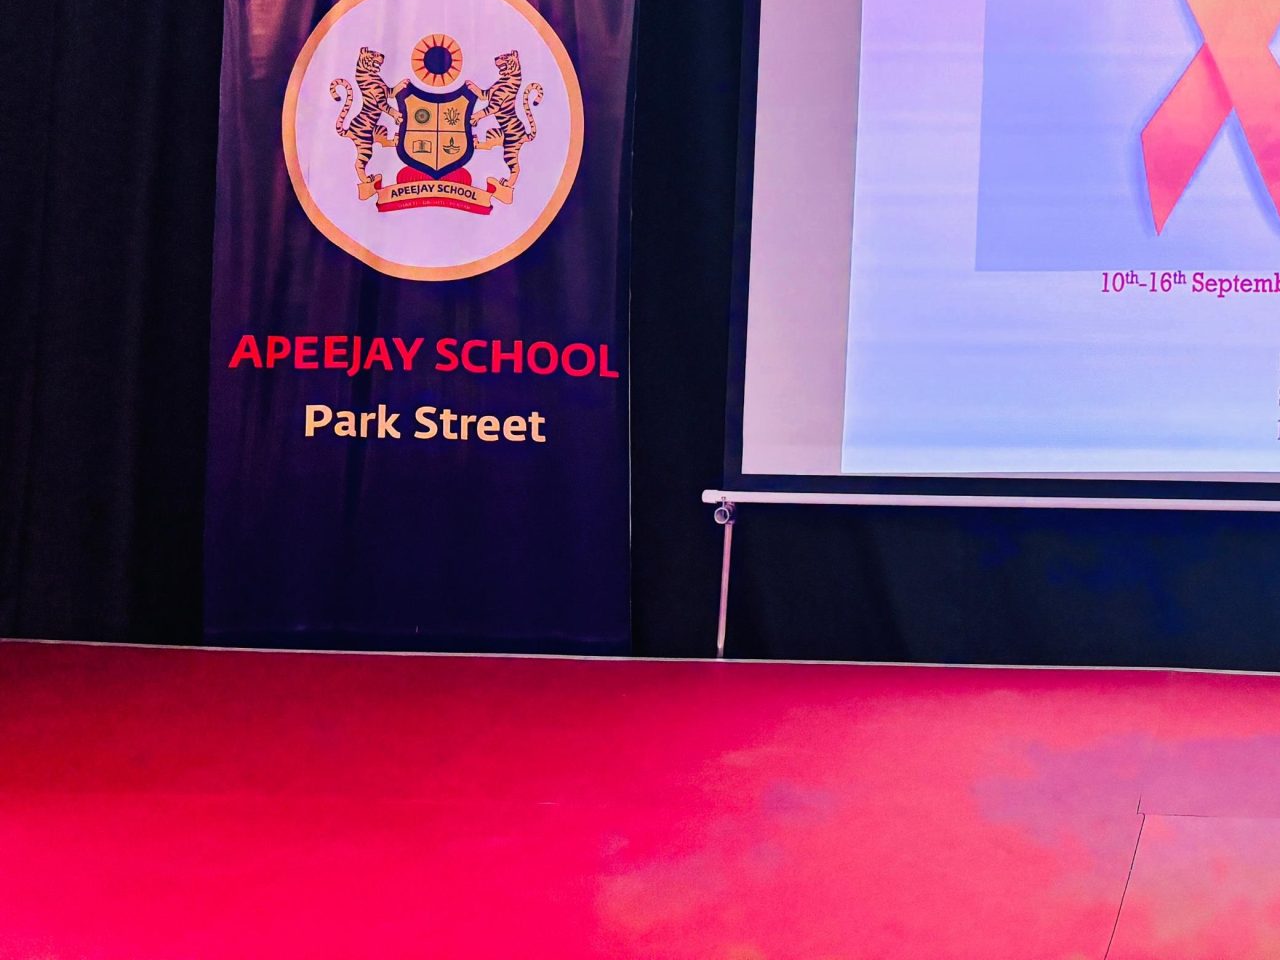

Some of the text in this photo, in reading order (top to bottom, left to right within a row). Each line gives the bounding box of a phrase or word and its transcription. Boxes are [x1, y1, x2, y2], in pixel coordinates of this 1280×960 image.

[390, 184, 478, 200] APEEJAY SCHOOL
[228, 334, 620, 379] APEEJAY SCHOOL
[304, 403, 547, 443] Park Street
